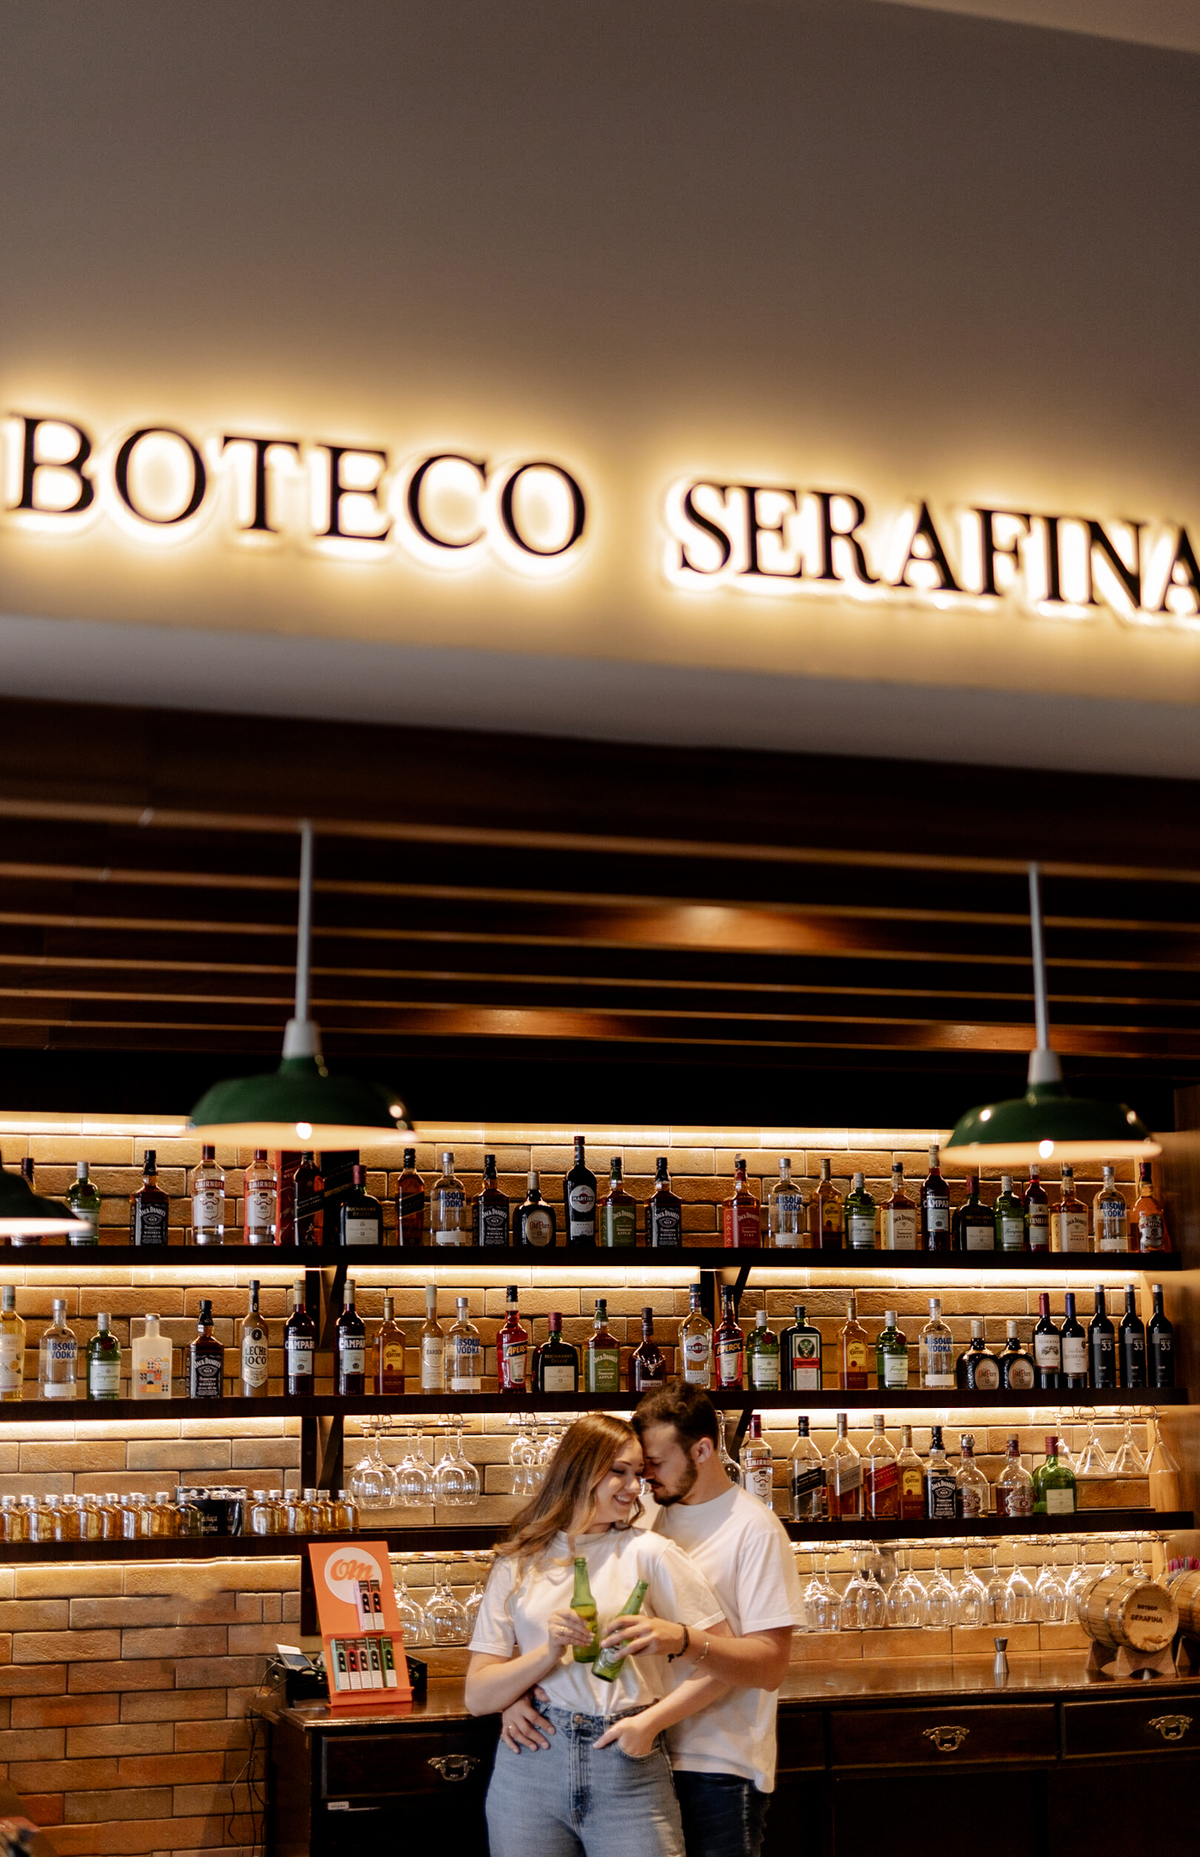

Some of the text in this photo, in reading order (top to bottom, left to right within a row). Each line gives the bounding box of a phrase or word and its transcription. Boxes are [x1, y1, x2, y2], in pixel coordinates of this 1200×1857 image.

[5, 415, 1200, 613] BOTECO SERAFINA
[245, 1346, 267, 1356] LECHE
[1101, 1343, 1112, 1351] 33
[1133, 1343, 1144, 1351] 33
[1161, 1343, 1171, 1351] 33
[51, 1351, 75, 1359] VODKA
[245, 1356, 267, 1366] LOCO
[1130, 1614, 1163, 1622] SERAFINA
